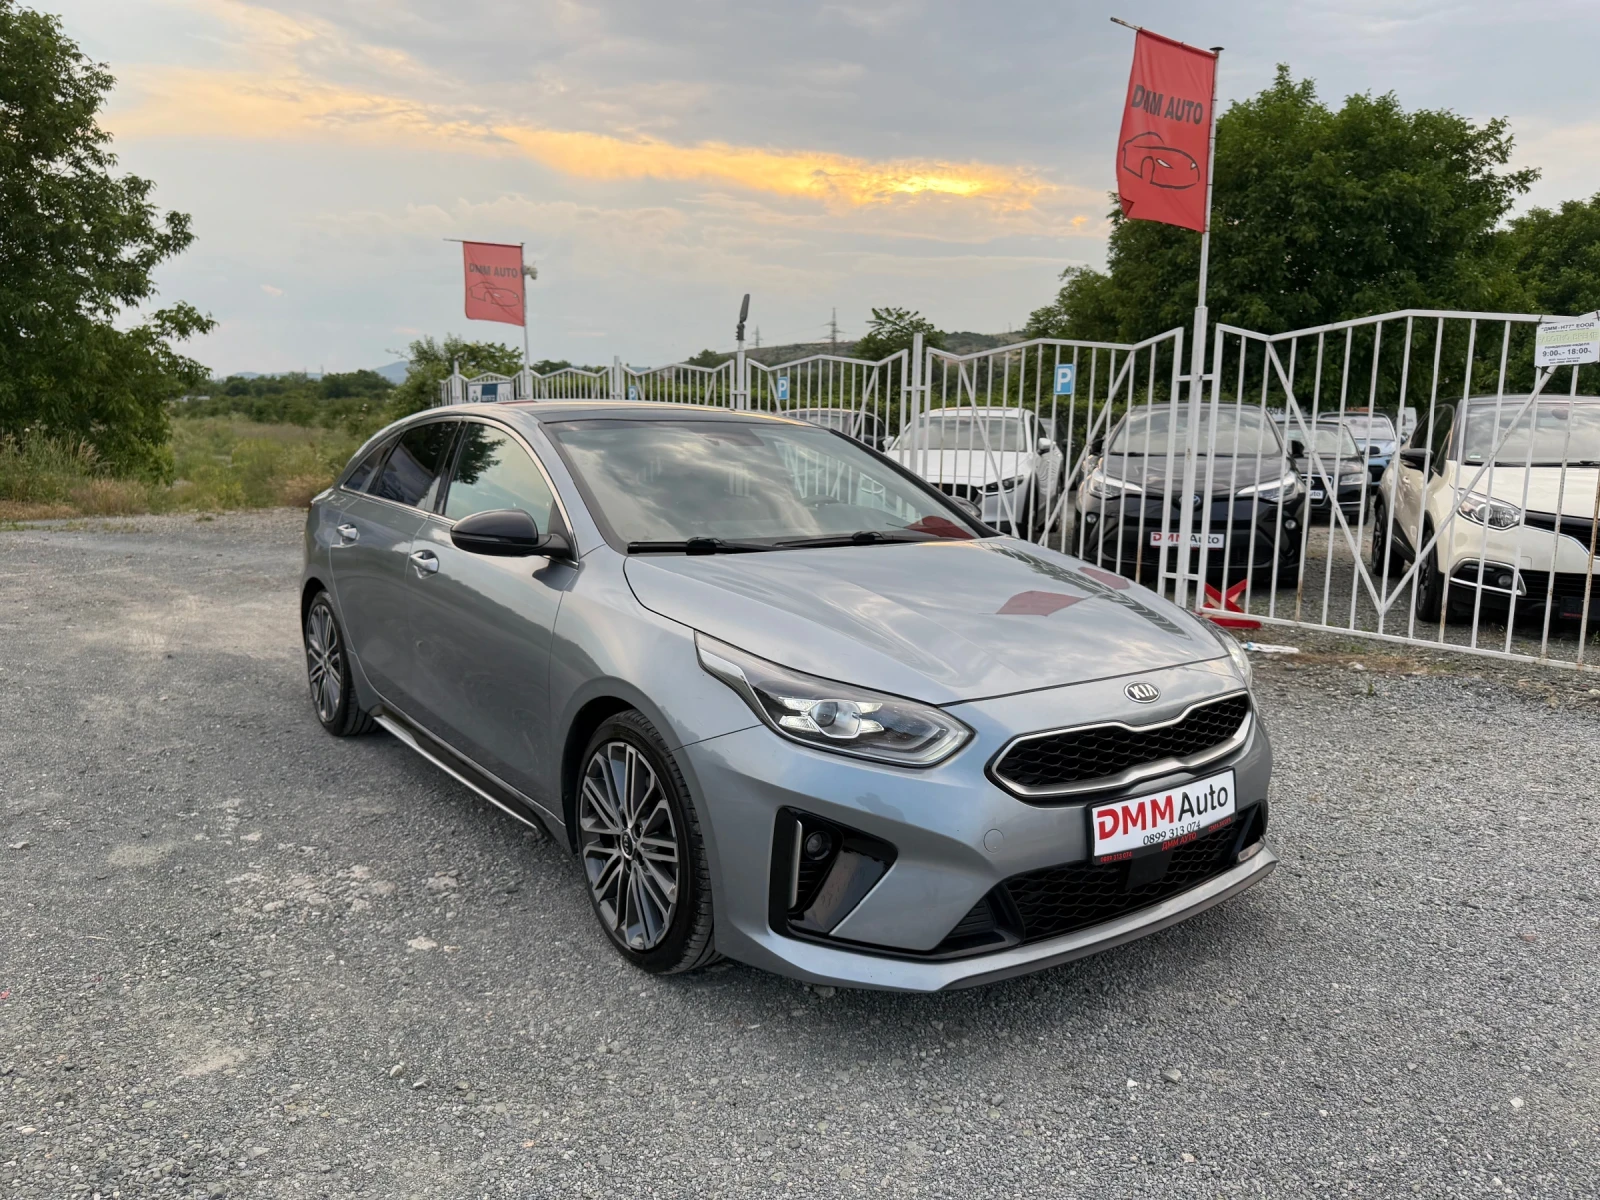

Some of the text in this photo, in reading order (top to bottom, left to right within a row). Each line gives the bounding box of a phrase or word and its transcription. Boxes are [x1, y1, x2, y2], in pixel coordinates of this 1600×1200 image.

[1131, 84, 1203, 125] DMM AUTO
[494, 267, 518, 278] AUTO
[778, 379, 787, 397] P
[1056, 368, 1072, 391] P
[1129, 684, 1158, 699] KIA
[1097, 783, 1228, 841] DMM Auto
[1142, 830, 1167, 846] 0899
[1168, 825, 1185, 839] 313
[1186, 820, 1201, 833] 074
[1161, 838, 1180, 851] ДММ
